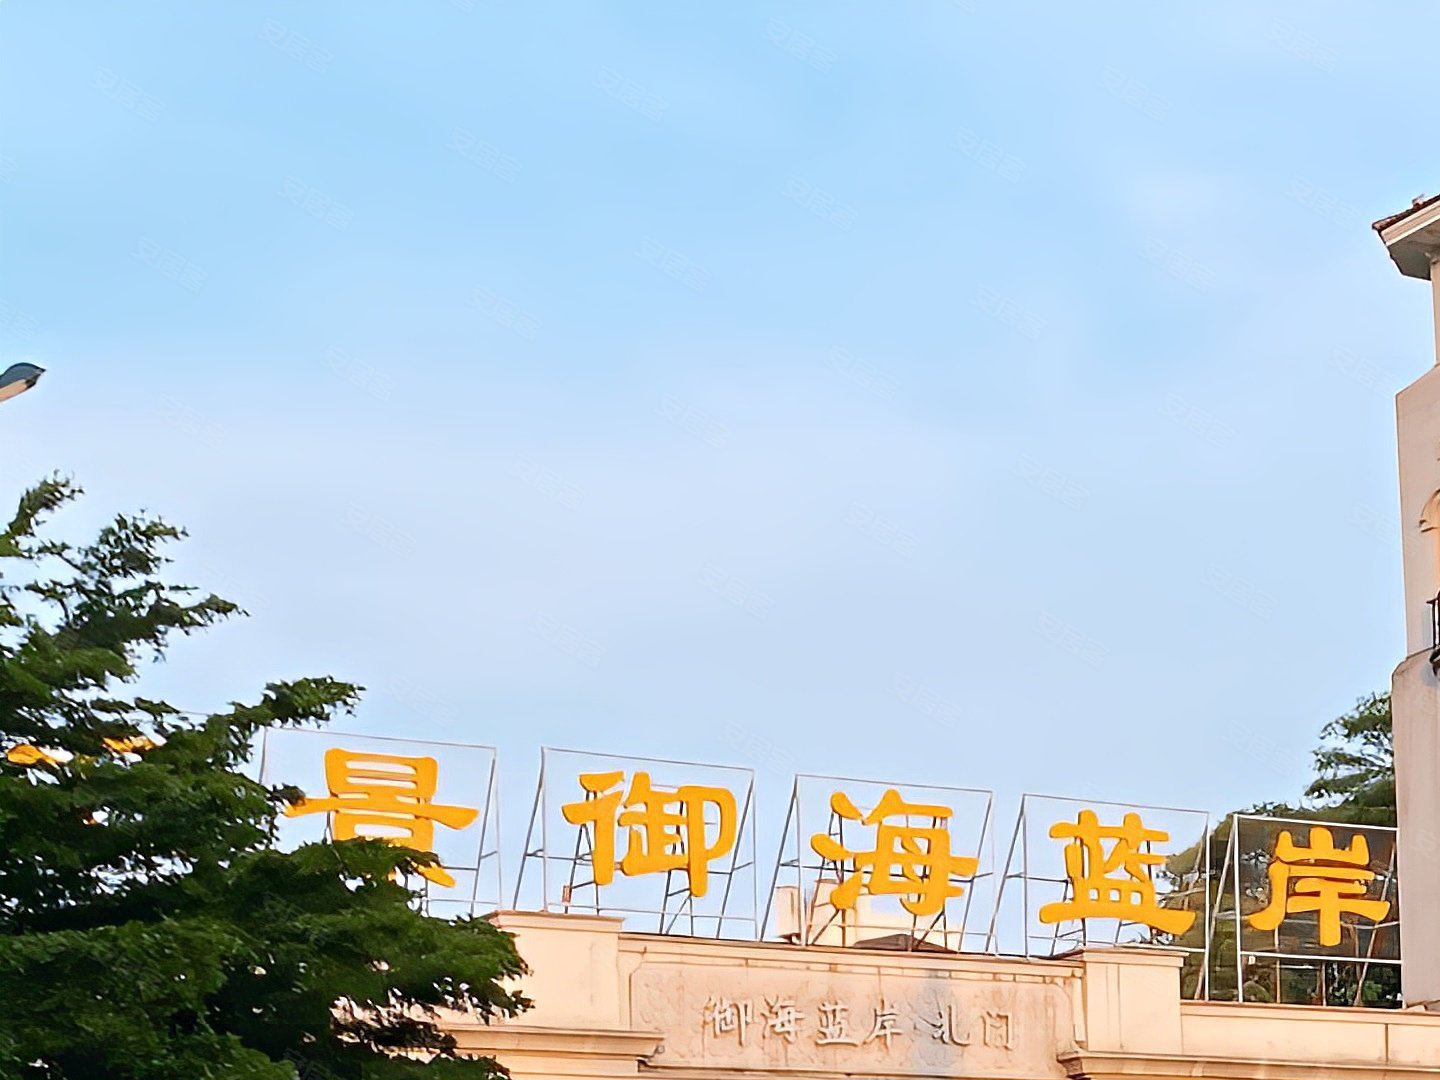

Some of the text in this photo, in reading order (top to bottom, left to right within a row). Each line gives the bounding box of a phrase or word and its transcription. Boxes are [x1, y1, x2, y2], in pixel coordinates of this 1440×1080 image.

[5, 734, 1392, 948] 景御海蓝岸
